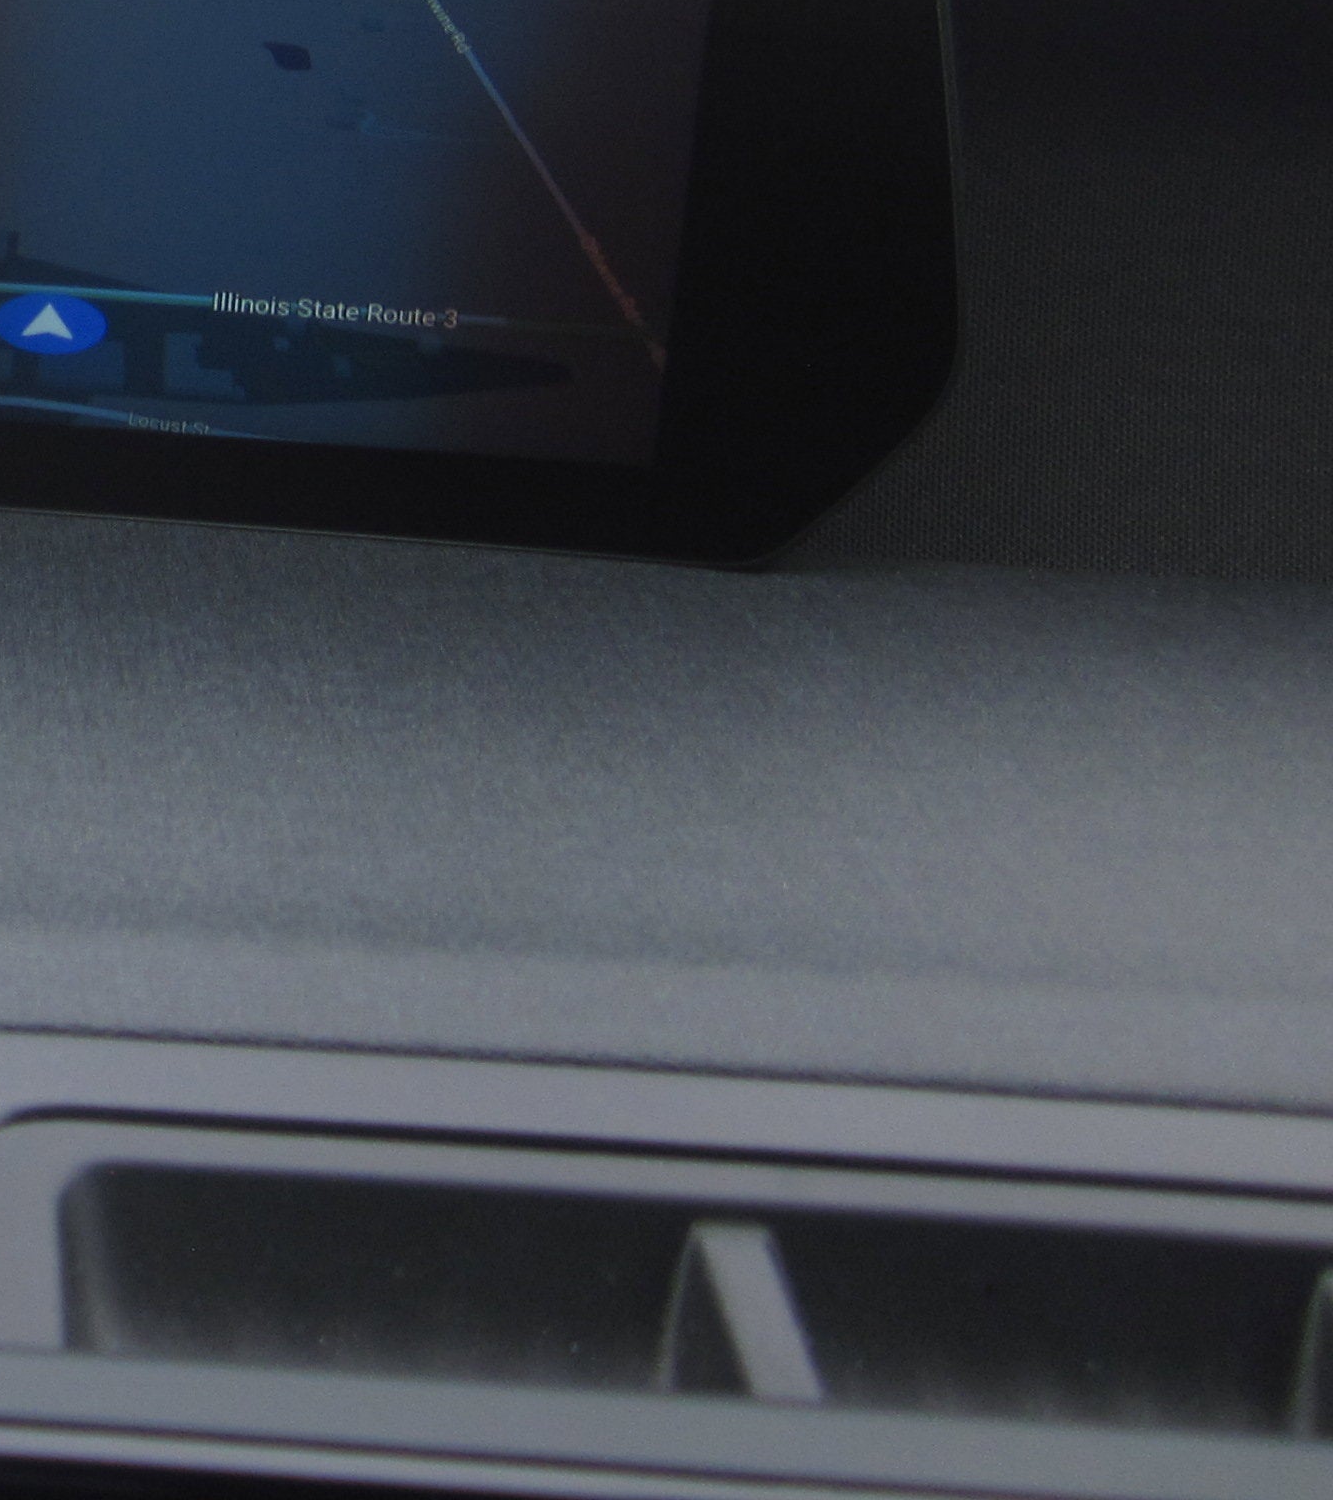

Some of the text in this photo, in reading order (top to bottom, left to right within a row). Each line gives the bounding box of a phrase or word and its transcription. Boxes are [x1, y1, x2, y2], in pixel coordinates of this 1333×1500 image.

[214, 291, 459, 330] Illinois State Route 3
